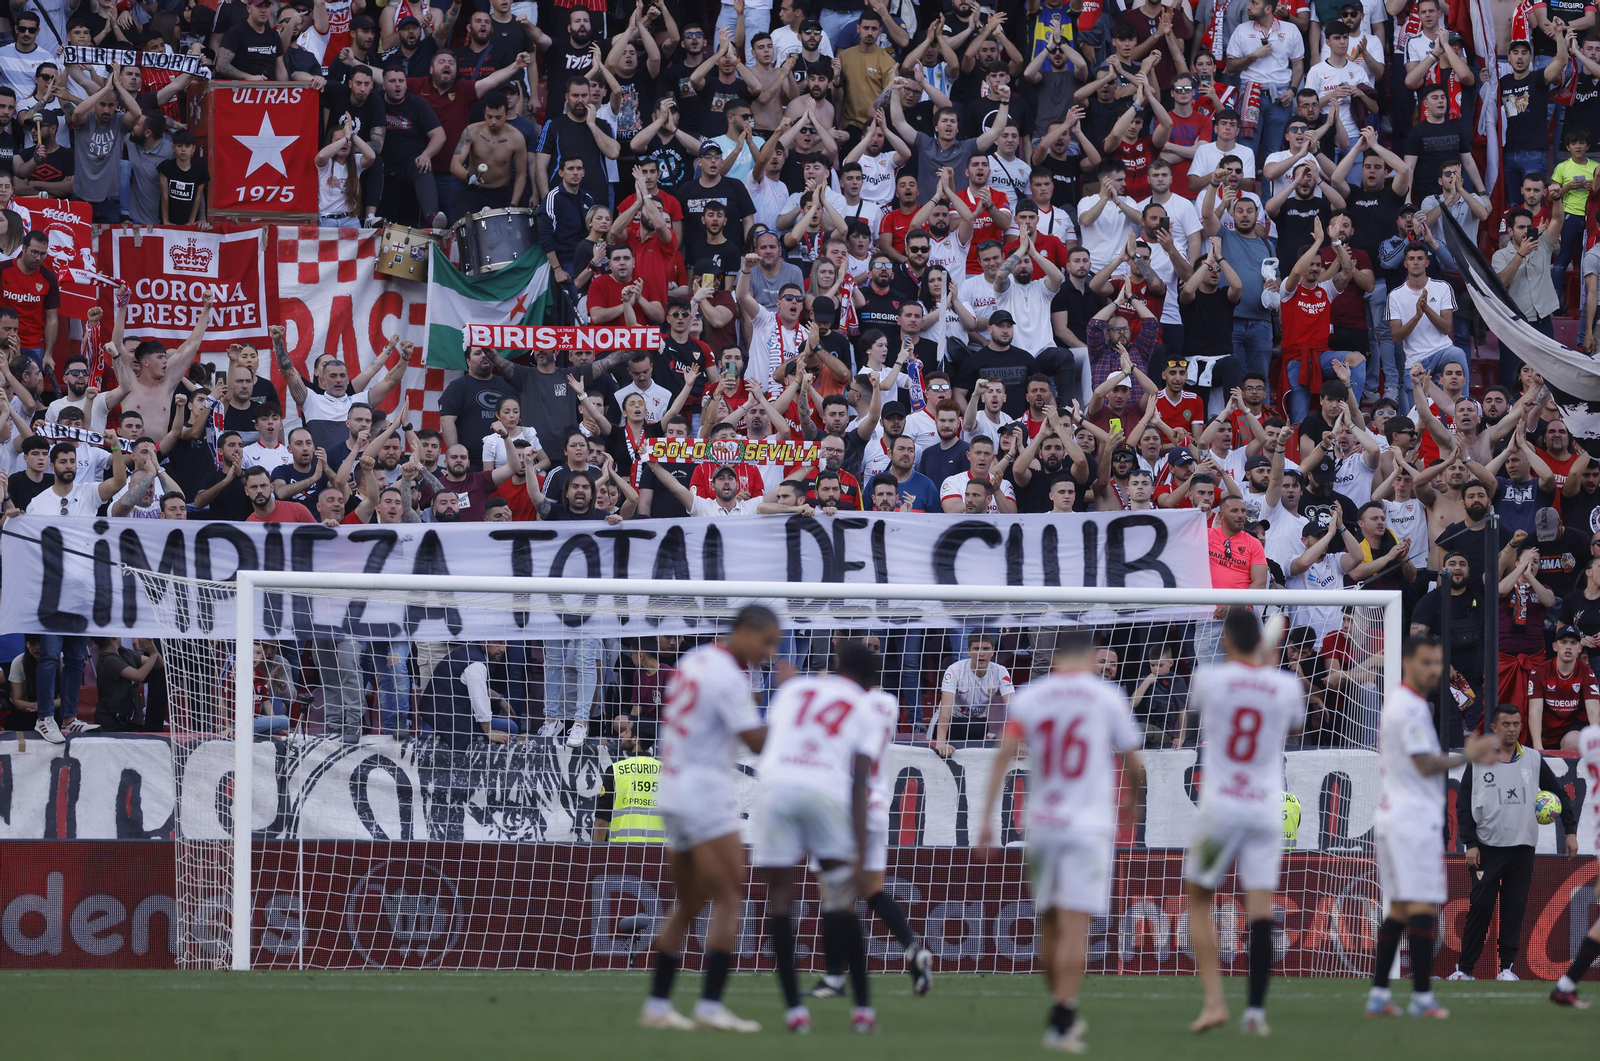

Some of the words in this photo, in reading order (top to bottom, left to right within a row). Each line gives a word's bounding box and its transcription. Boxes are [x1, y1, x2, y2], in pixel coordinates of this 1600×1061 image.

[1559, 1, 1584, 9] DEGIRO
[64, 46, 137, 65] BIRIS
[232, 88, 303, 104] ULTRAS
[1514, 85, 1529, 93] LOVE
[992, 176, 1026, 188] Playika
[170, 188, 190, 198] ULTRAS
[235, 185, 295, 203] 1975
[41, 206, 81, 225] SECCION
[3, 289, 41, 303] Playtika
[135, 277, 248, 303] CORONA
[126, 302, 257, 328] PRESENTE
[471, 326, 557, 350] BIRIS
[576, 327, 661, 350] NORTE
[37, 422, 102, 443] IRIS
[651, 440, 706, 460] SOLO
[743, 442, 819, 463] SEVILLA
[1208, 550, 1247, 567] MARATHON
[1218, 559, 1233, 568] BET
[488, 523, 737, 629] TOTAL
[784, 513, 924, 623] DEL
[931, 514, 1178, 625] CLUB
[795, 690, 853, 736] 14
[1225, 706, 1264, 764] 8
[1036, 714, 1089, 782] 16
[631, 781, 659, 792] 1595
[629, 797, 658, 806] PROSEG
